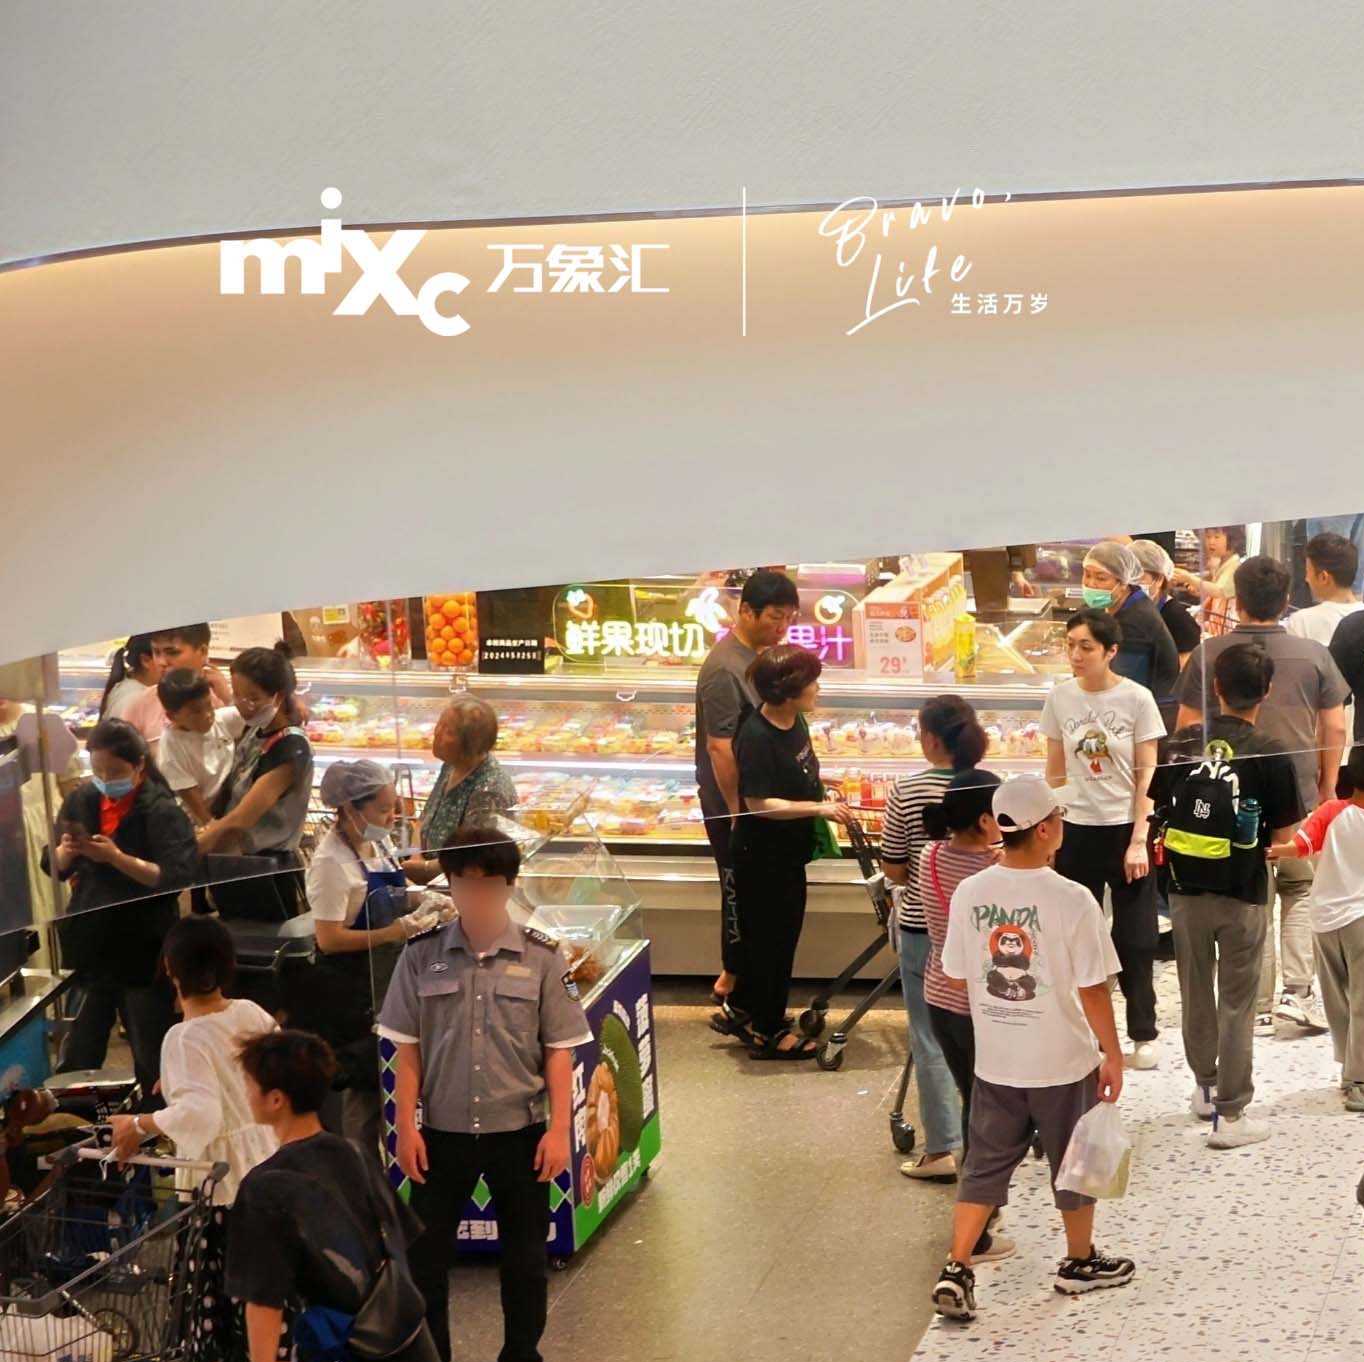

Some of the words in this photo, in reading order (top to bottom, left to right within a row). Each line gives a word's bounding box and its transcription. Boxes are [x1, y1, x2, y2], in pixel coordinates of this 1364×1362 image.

[564, 619, 706, 658] 鲜果现切
[971, 903, 1042, 933] PANDA
